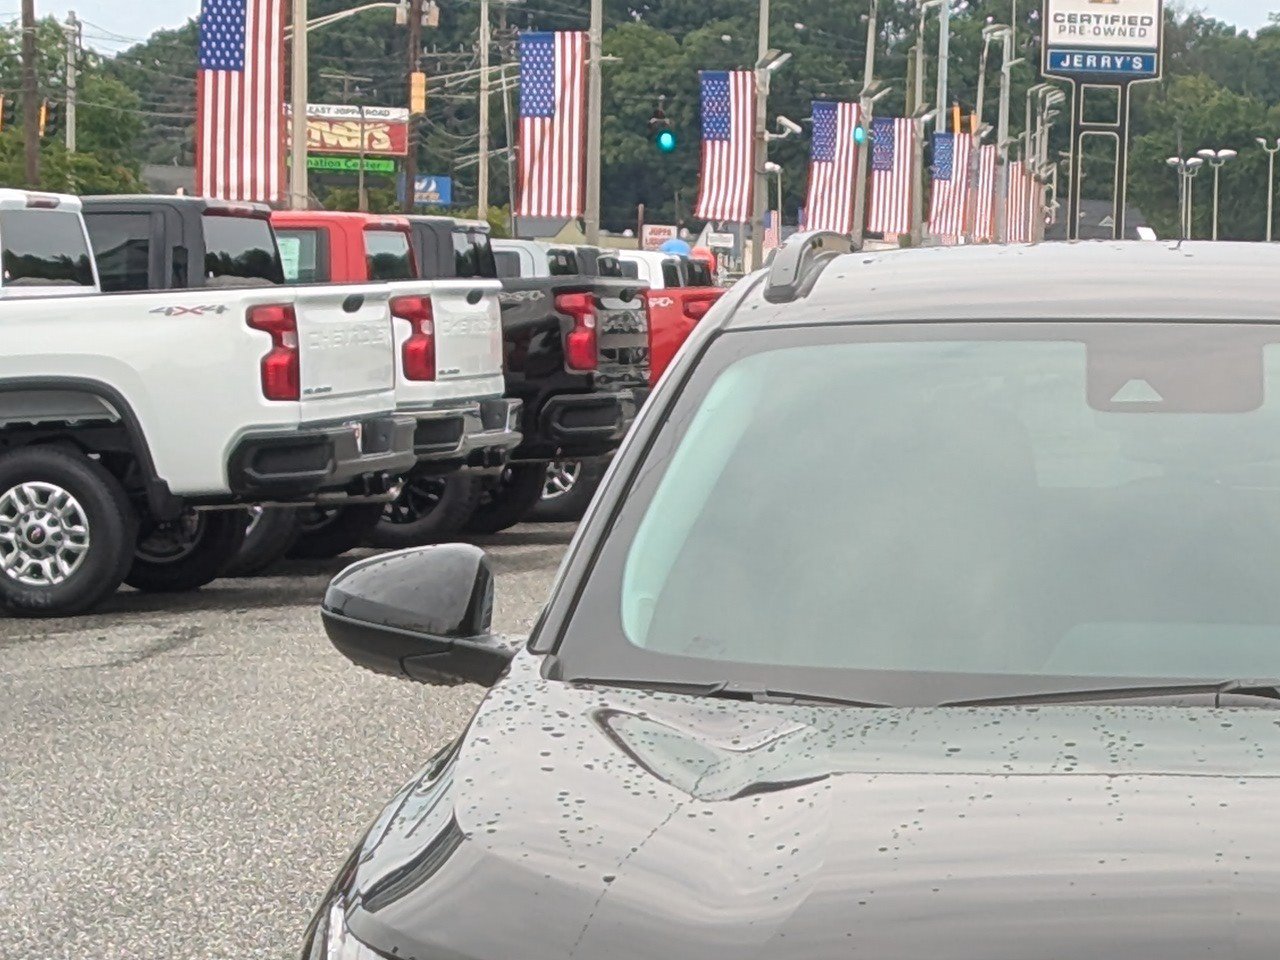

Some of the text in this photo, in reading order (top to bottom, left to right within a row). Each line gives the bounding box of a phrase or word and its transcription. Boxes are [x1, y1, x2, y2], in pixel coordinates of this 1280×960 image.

[1053, 13, 1153, 27] CERTIFIED
[1058, 25, 1147, 38] PRE-OWNED
[1060, 54, 1143, 70] JERRY'S
[308, 106, 331, 115] EAST
[365, 109, 390, 117] ROAD
[344, 159, 382, 169] Ceter
